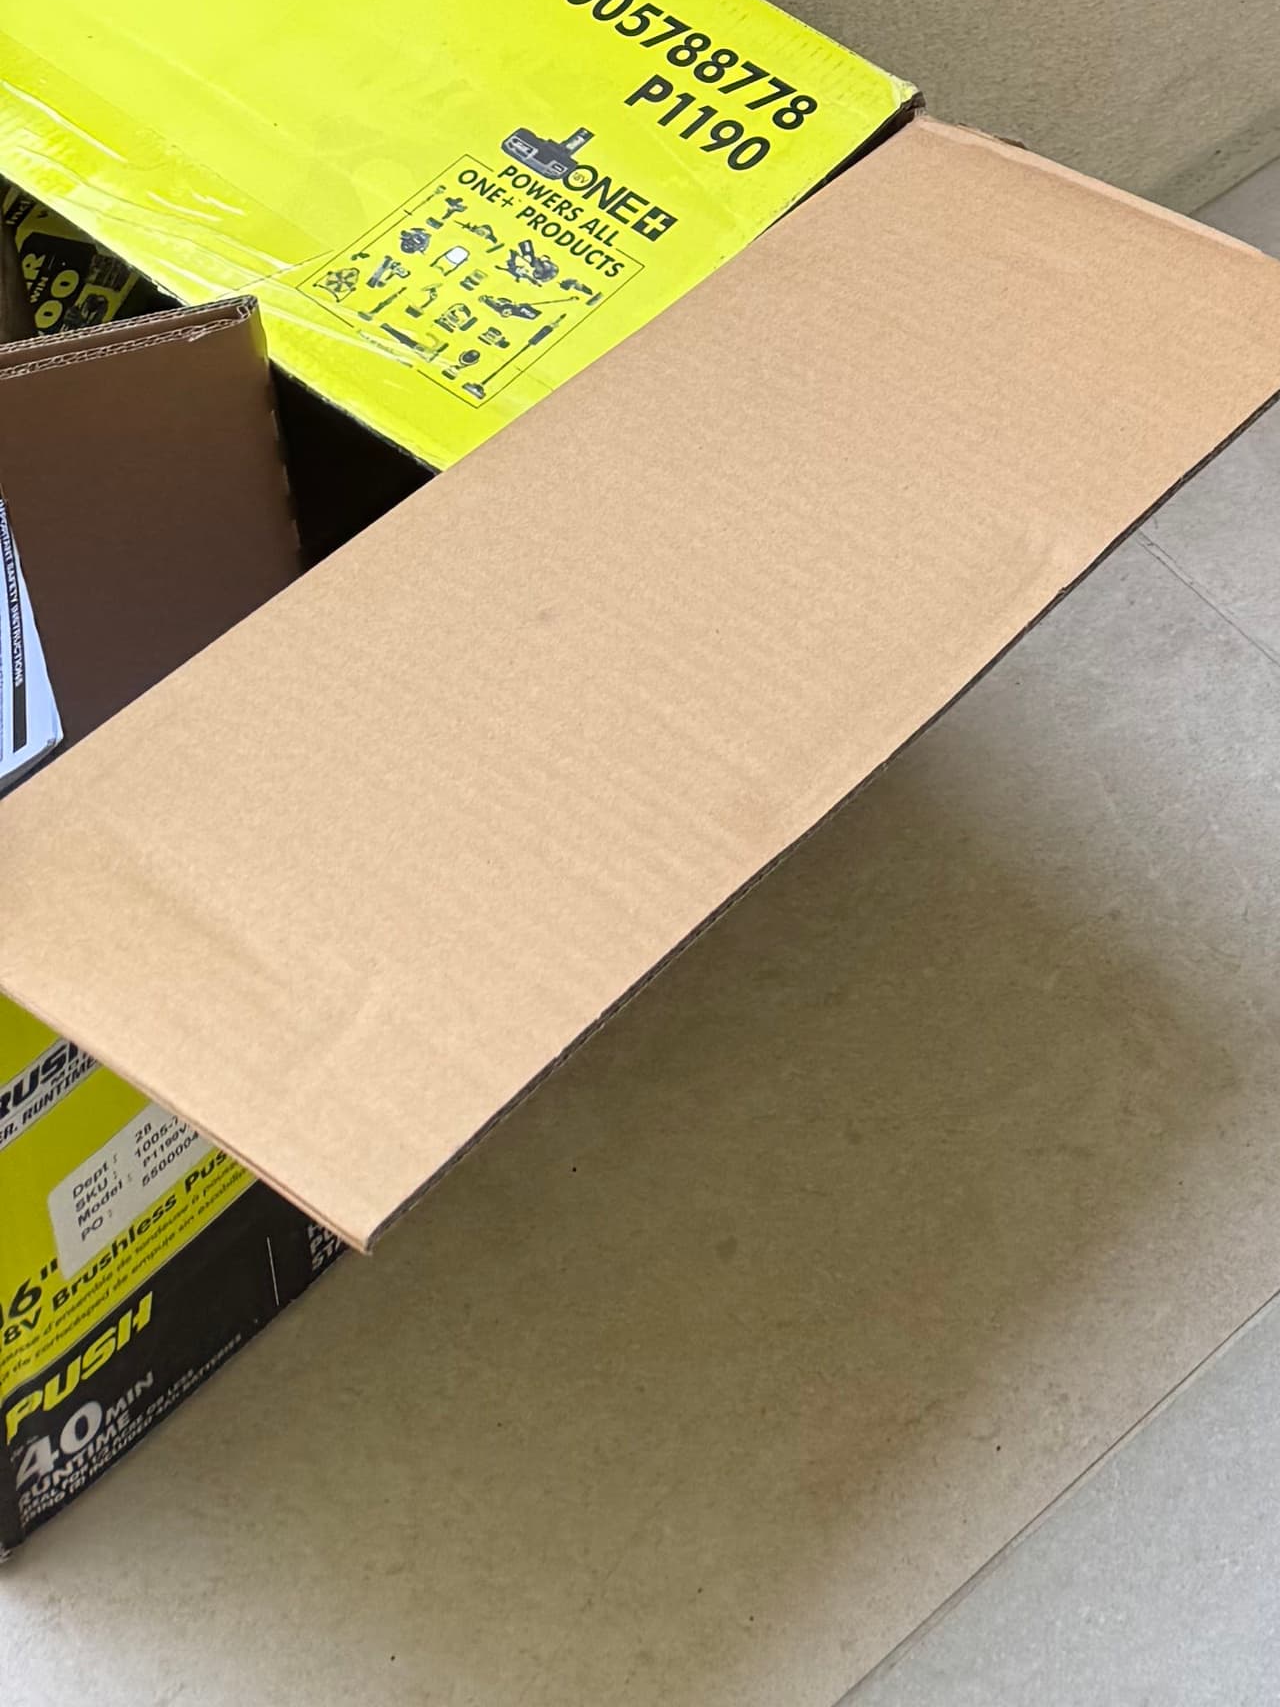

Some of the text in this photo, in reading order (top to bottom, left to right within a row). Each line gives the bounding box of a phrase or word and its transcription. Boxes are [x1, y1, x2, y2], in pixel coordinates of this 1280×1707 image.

[623, 74, 771, 171] P1190
[497, 165, 620, 248] POWERS ALL
[515, 204, 626, 279] PRODUCTS
[72, 1162, 109, 1200] Dept
[75, 1177, 109, 1213] SKU
[77, 1180, 123, 1227] Model
[52, 1193, 177, 1312] Brushless
[81, 1216, 104, 1242] PO
[6, 1290, 153, 1446] PUSH
[16, 1371, 154, 1492] 40 MIN
[18, 1409, 131, 1513] RUNTIME
